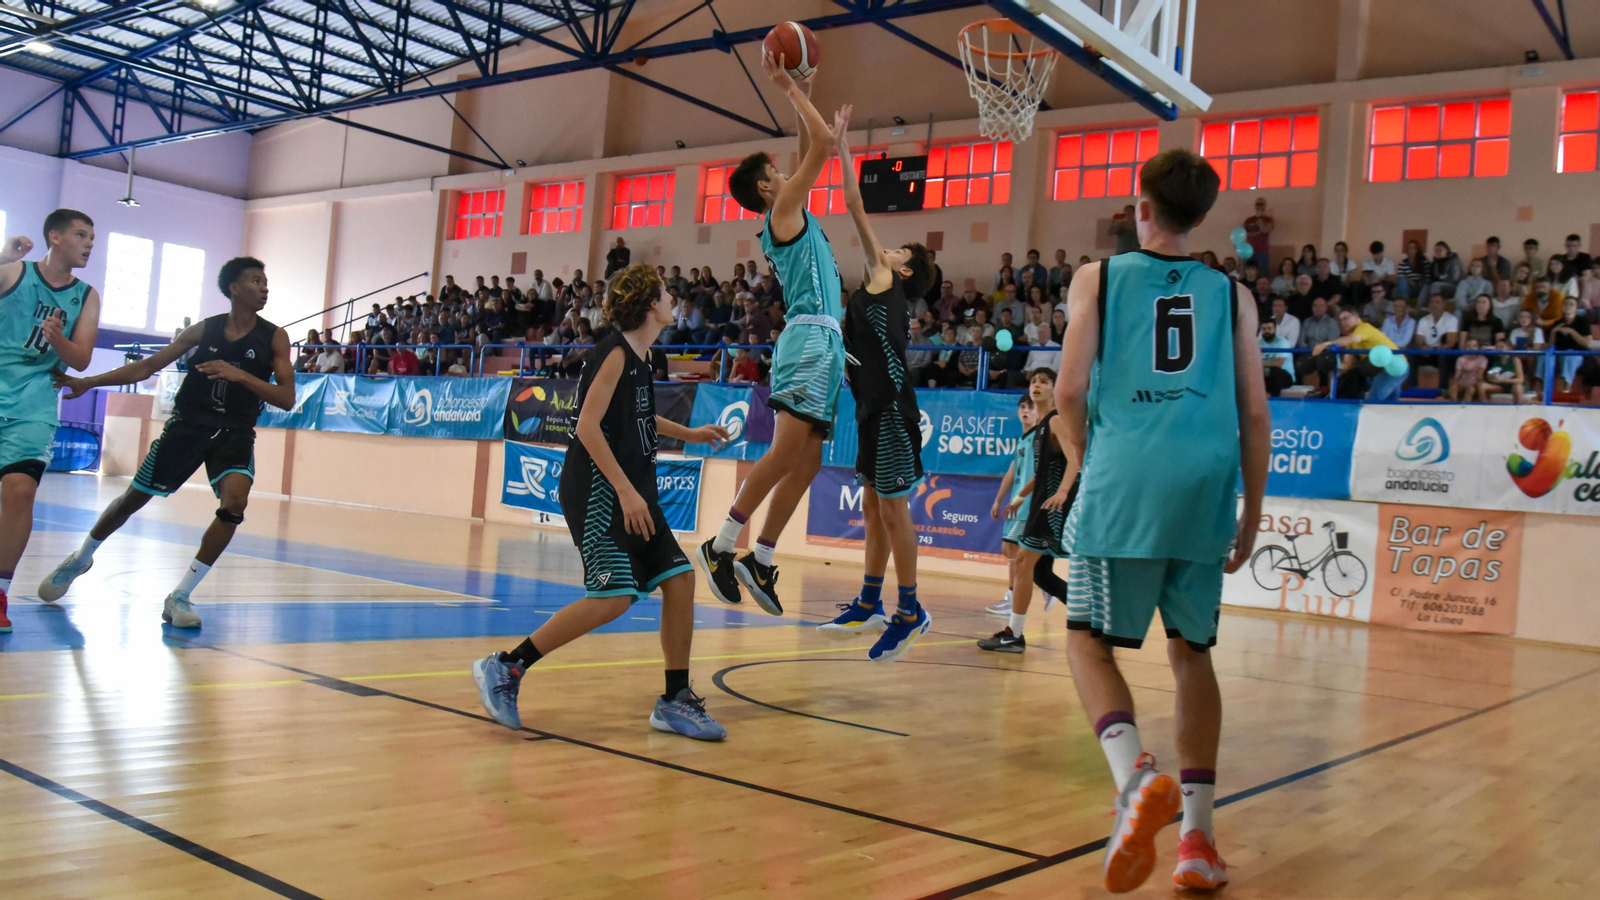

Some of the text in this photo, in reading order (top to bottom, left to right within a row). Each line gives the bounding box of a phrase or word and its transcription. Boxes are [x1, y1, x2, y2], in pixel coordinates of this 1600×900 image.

[1152, 293, 1197, 375] 6
[941, 415, 1009, 436] BASKET
[1386, 466, 1455, 481] baloncesto
[942, 510, 979, 524] Seguros
[927, 525, 966, 536] CARREÑO
[1388, 515, 1507, 551] Bar de
[918, 535, 933, 544] 743
[1388, 545, 1502, 584] Tapas
[1276, 572, 1356, 619] Puri
[1409, 589, 1440, 600] Padre
[1484, 596, 1498, 606] 16
[1417, 613, 1431, 622] La
